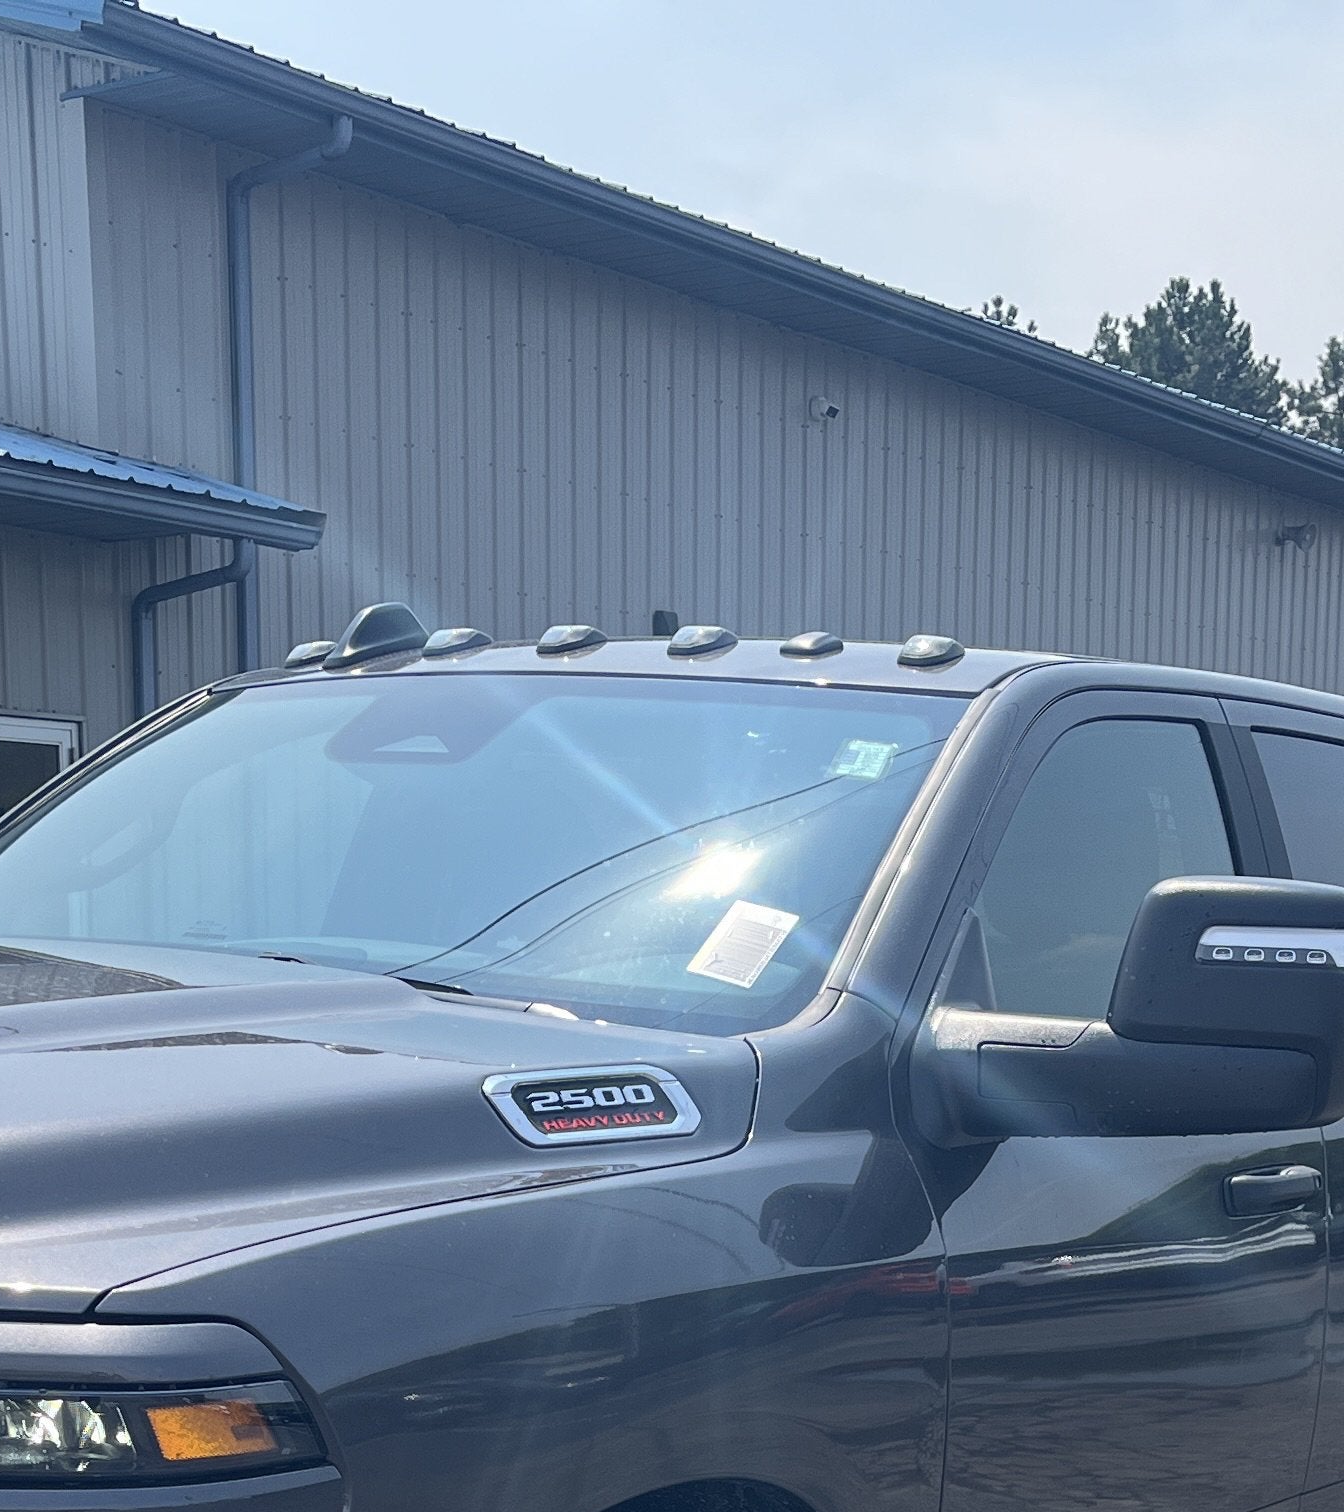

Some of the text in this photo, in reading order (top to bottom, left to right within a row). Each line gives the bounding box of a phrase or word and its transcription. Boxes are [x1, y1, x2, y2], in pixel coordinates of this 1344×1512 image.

[527, 1084, 655, 1111] 2500
[542, 1110, 666, 1132] HEAVY DUTY
